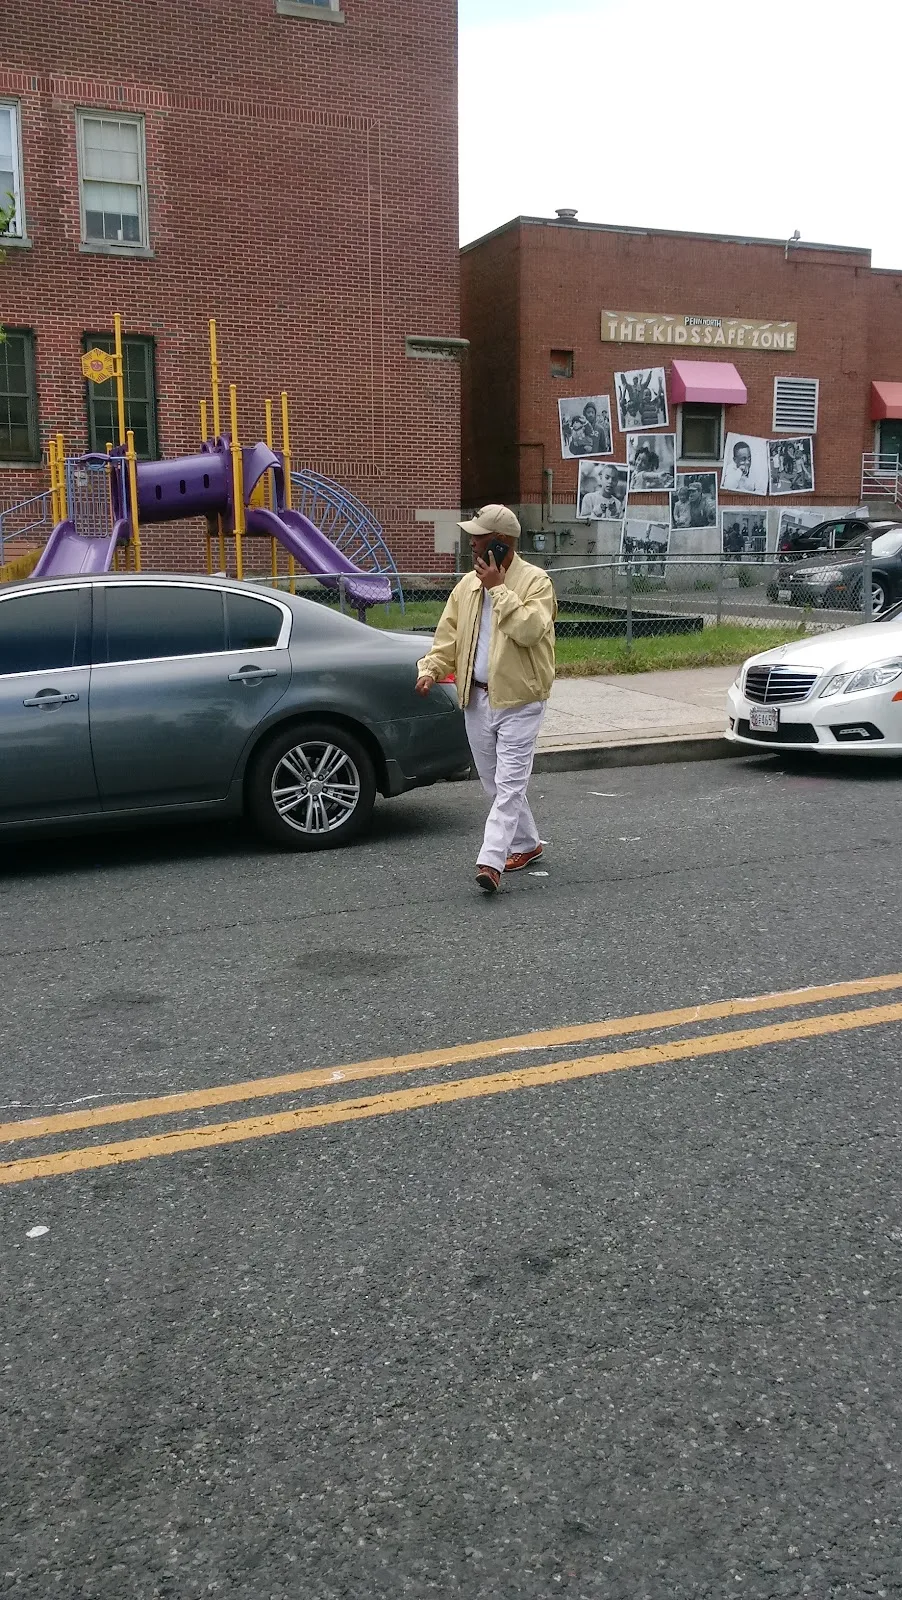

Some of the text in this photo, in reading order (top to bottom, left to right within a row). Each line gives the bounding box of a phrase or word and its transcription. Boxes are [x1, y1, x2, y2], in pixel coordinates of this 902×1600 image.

[684, 316, 722, 328] PENN NORTH
[608, 320, 795, 349] THE KIDS SAFE ZONE
